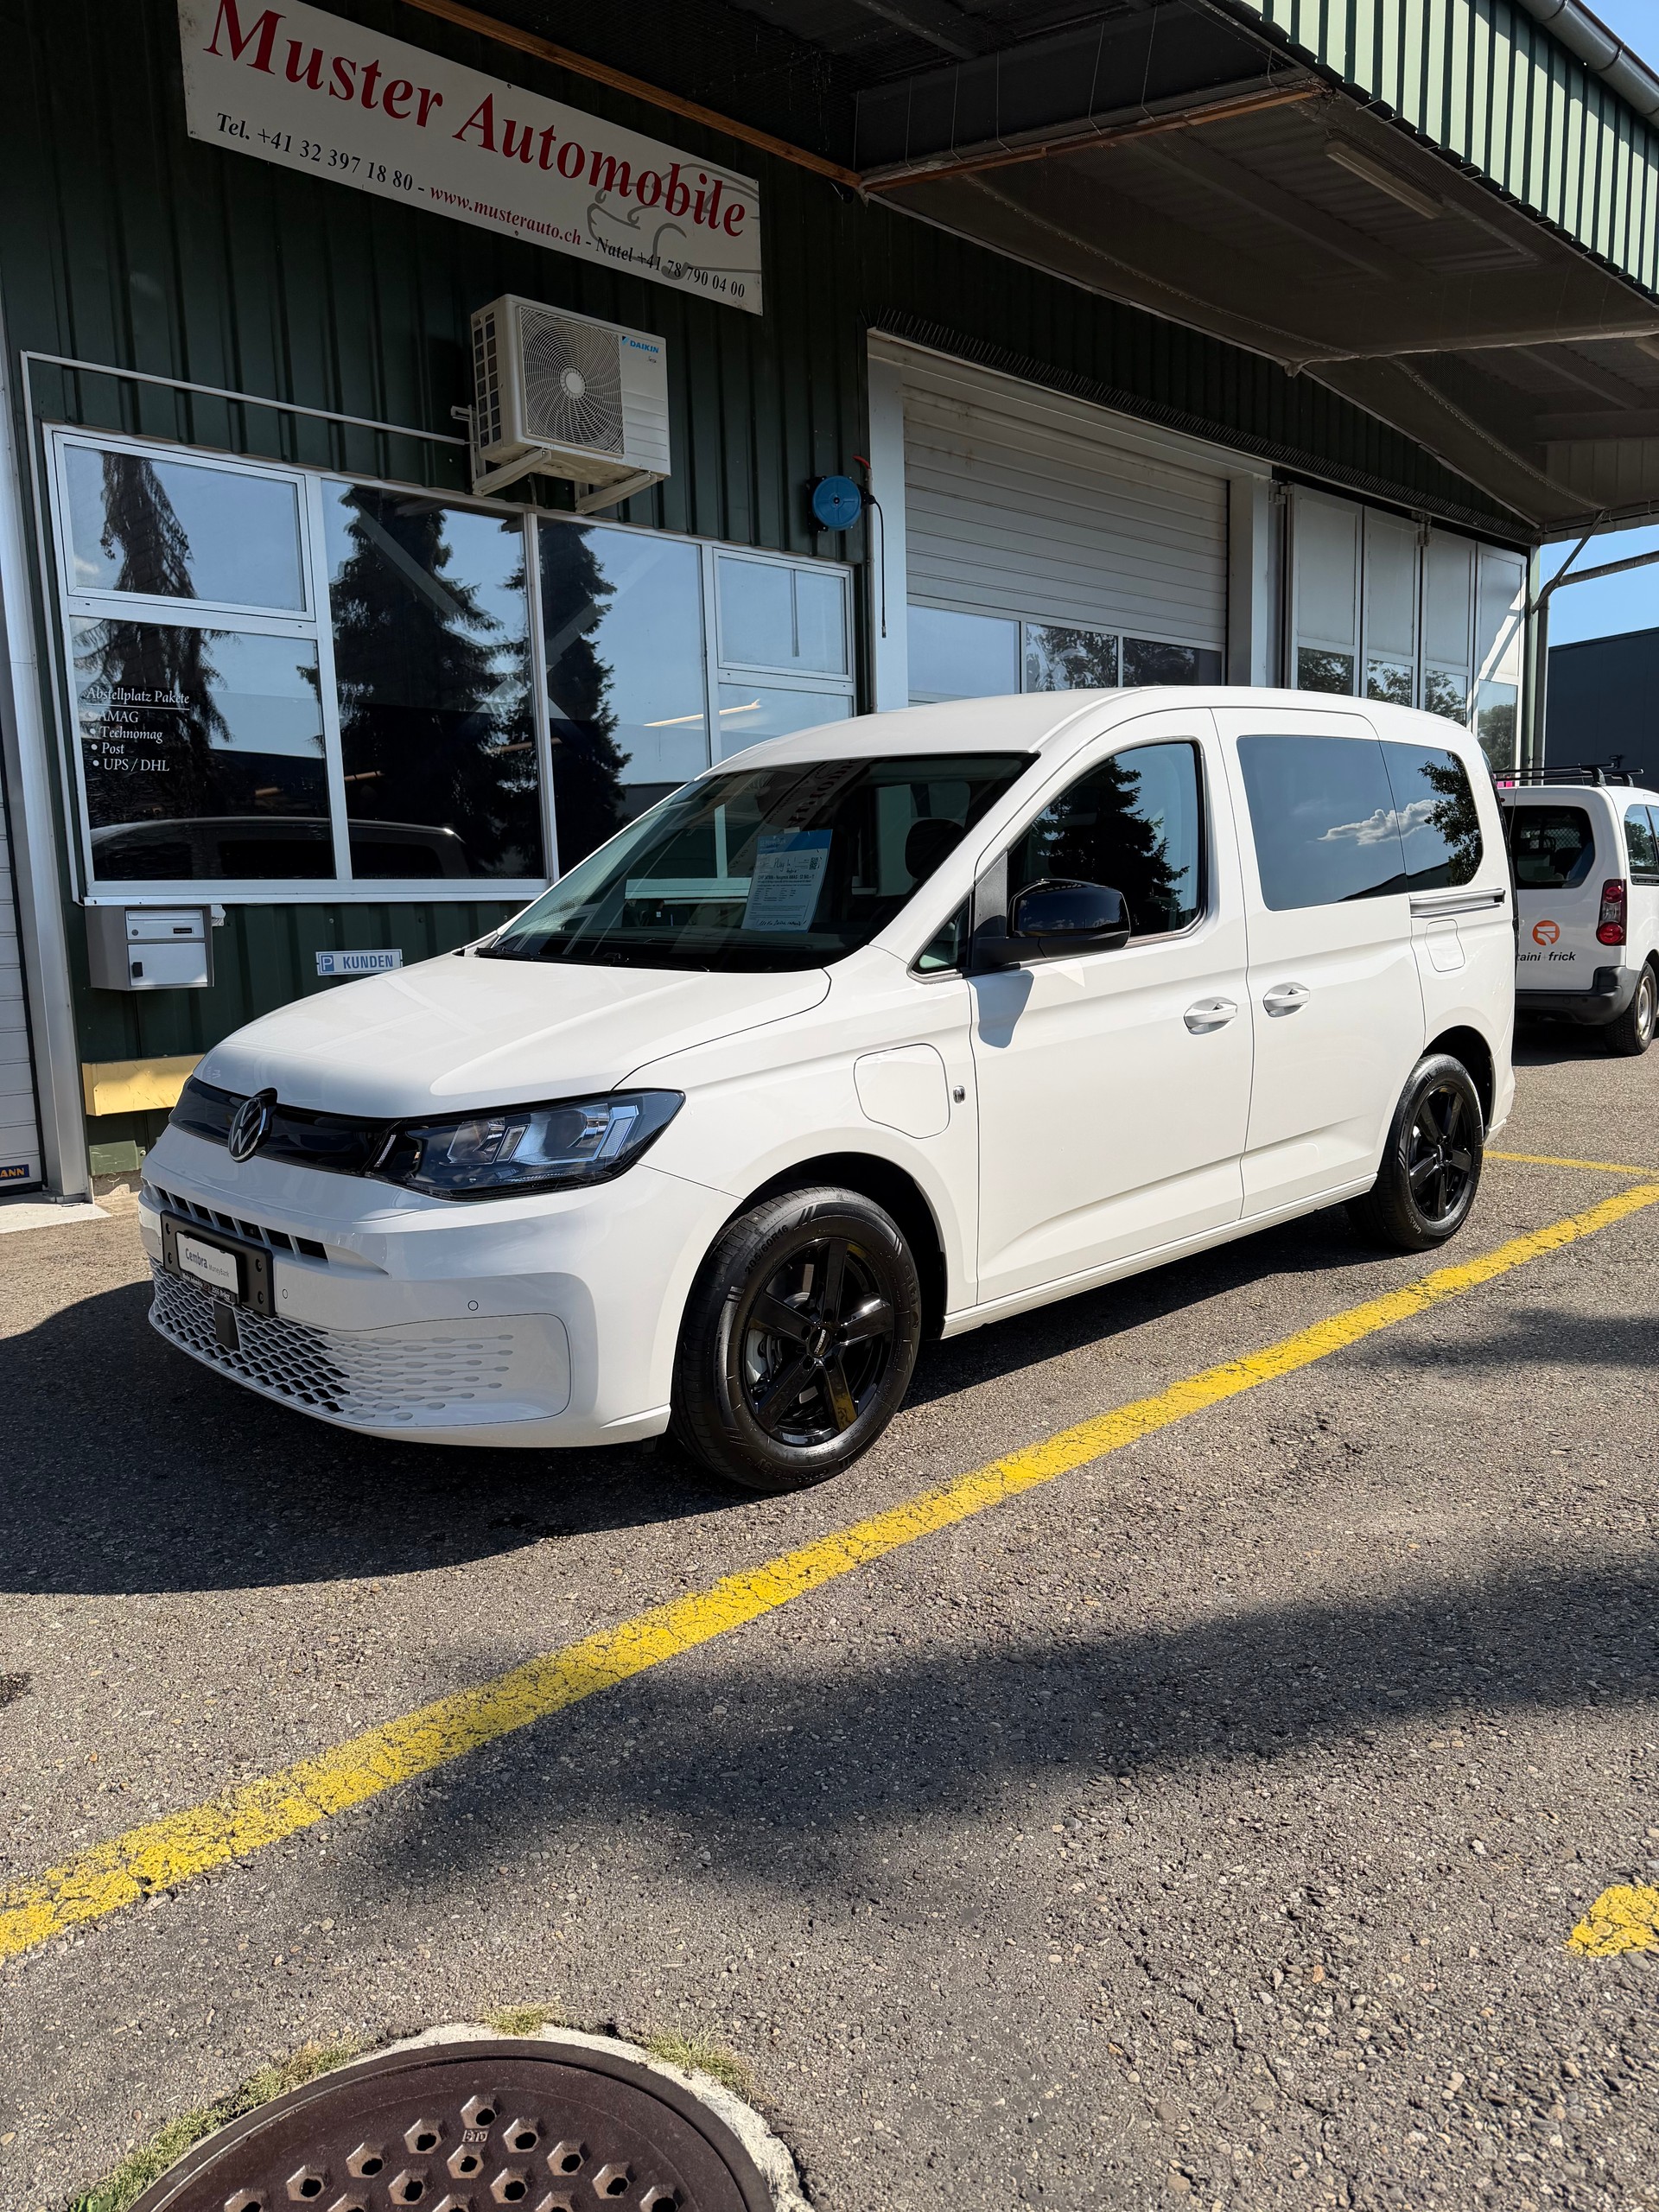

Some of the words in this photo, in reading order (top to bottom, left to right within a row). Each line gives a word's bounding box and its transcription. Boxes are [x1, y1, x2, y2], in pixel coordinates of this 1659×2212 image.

[203, 0, 443, 128] Muster
[452, 92, 746, 238] Automobile
[216, 112, 251, 140] Tel.
[257, 128, 291, 153] +41
[299, 140, 321, 162] 32
[327, 149, 361, 174] 397
[366, 161, 386, 182] 18
[392, 170, 413, 191] 80
[429, 186, 582, 246] www.musterauto.ch
[595, 236, 633, 263] Natel
[637, 251, 661, 271] +41
[667, 259, 682, 277] 78
[687, 266, 709, 287] 790
[712, 277, 727, 294] 04
[730, 281, 746, 298] 00
[630, 340, 659, 353] DAIKIN
[86, 687, 152, 705] Abstellplatz
[154, 690, 190, 704] Pakete
[99, 710, 139, 723] AMAG
[99, 726, 163, 744] Technomag
[101, 741, 125, 754] Post
[104, 758, 130, 771] UPS
[140, 759, 170, 772] DHL
[342, 955, 393, 969] KUNDEN
[185, 1247, 208, 1269] Cembra
[744, 1224, 789, 1275] 205/60R16
